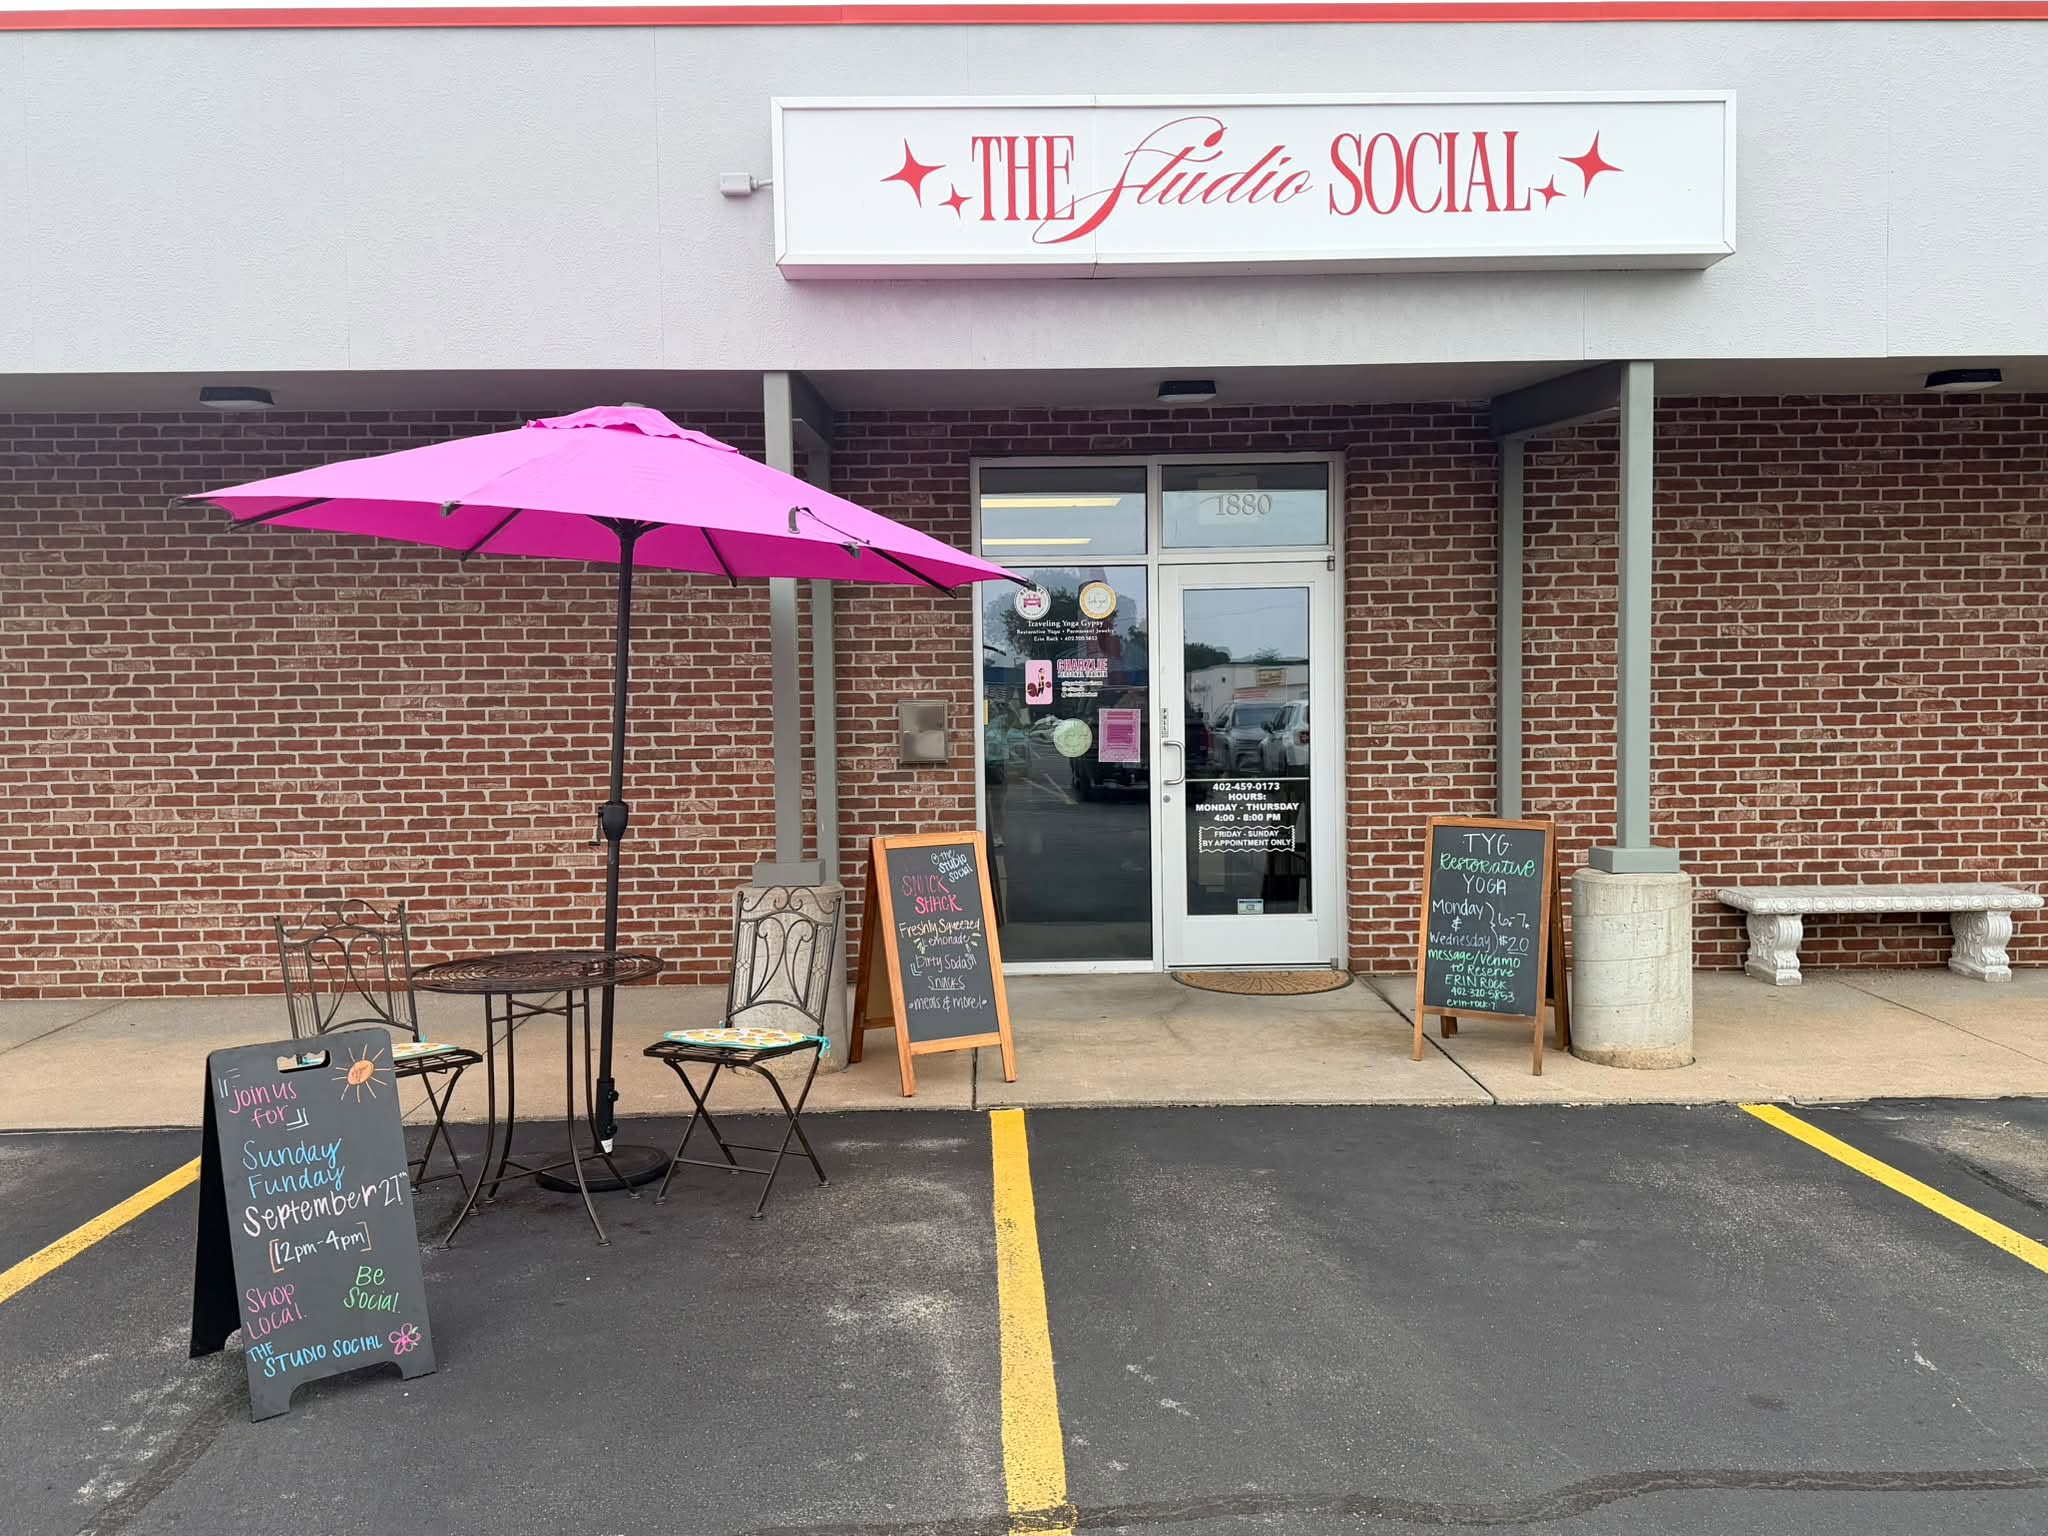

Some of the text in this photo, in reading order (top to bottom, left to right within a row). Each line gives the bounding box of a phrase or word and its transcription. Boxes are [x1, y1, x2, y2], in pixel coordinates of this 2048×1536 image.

[971, 116, 1531, 244] THE Studio SOCIAL
[1215, 493, 1272, 516] 1880
[1028, 619, 1103, 628] Traveling Yoga Gypsy
[1212, 782, 1280, 791] 402-459-0173
[1228, 793, 1266, 801] HOURS:
[1195, 803, 1238, 812] MONDAY
[1246, 802, 1299, 811] THURSDAY
[1214, 814, 1234, 822] 4:00
[1243, 814, 1264, 822] 8:00
[1266, 813, 1281, 821] PM
[1202, 838, 1292, 847] BY APPOINTMENT ONLY
[1214, 830, 1242, 838] FRIDAY
[1463, 832, 1510, 856] TYG
[1462, 873, 1507, 896] YOGA
[1432, 898, 1484, 920] Monday
[899, 917, 980, 939] Freshly Squeezed
[1429, 931, 1491, 953] Wednesday
[915, 954, 942, 973] Dirty
[1467, 964, 1515, 978] Reserve
[1445, 974, 1478, 986] ERIN
[272, 1080, 297, 1101] us
[251, 1104, 288, 1129] for
[242, 1137, 342, 1171] Sunday
[248, 1165, 346, 1199] Funday
[243, 1180, 377, 1238] September
[355, 1265, 386, 1287] Be
[247, 1341, 275, 1364] THE
[263, 1335, 384, 1379] STUDIO SOCIAL
